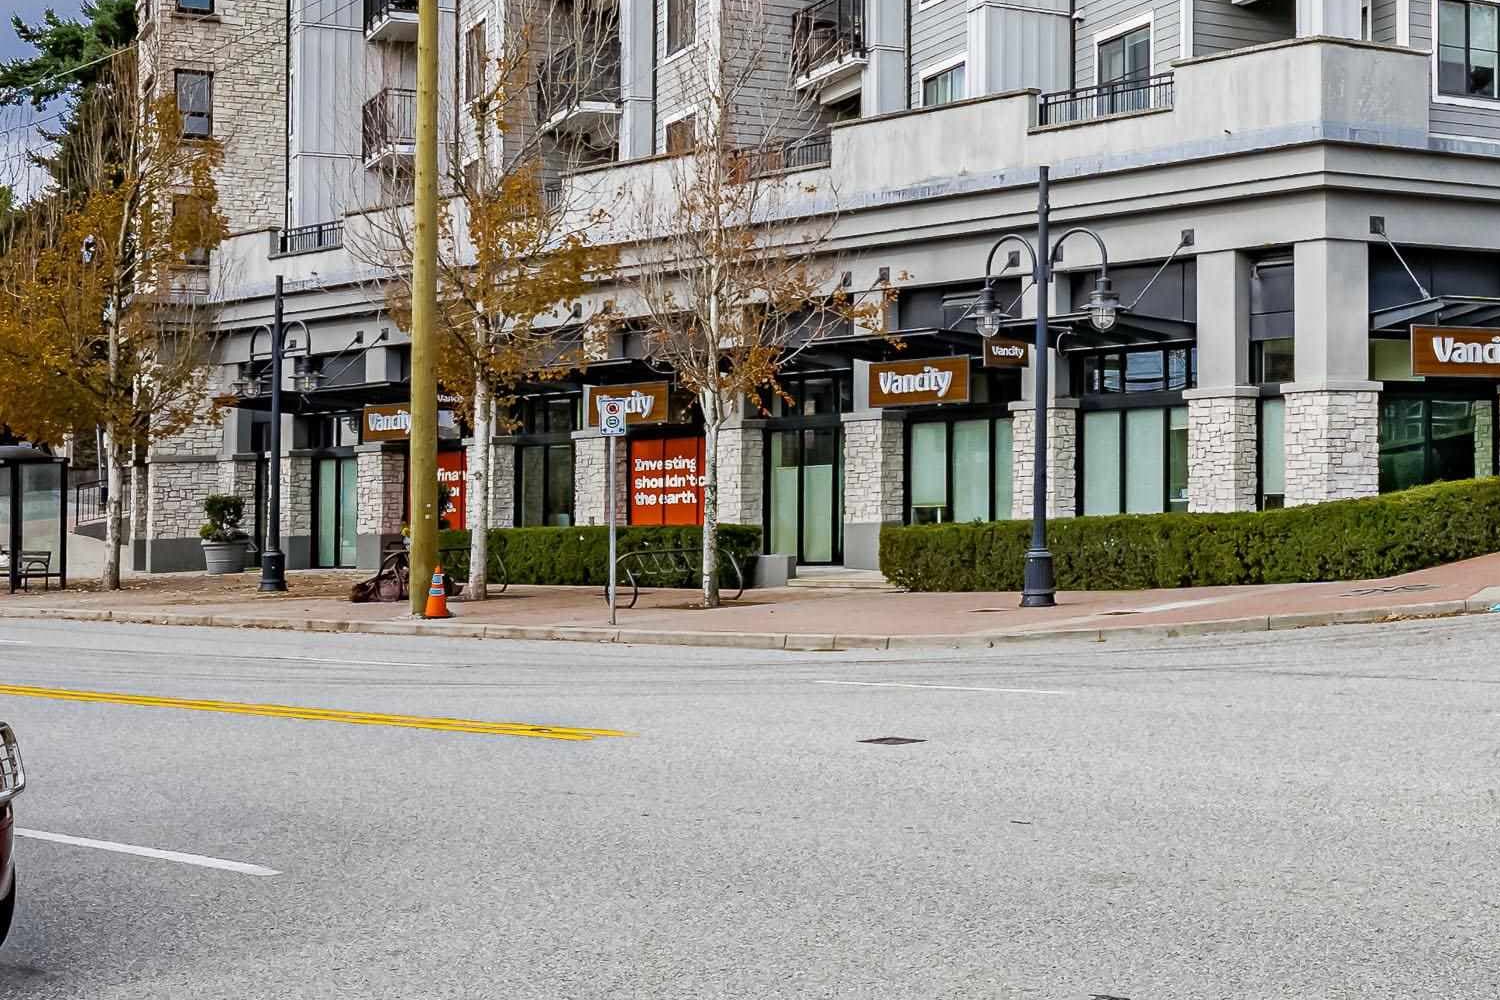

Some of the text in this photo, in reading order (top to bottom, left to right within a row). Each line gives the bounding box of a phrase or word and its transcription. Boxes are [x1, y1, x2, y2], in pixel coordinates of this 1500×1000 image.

[992, 345, 1024, 359] Vancity
[879, 366, 953, 397] Vancity
[634, 456, 697, 473] Investing
[634, 474, 697, 489] shouldn't
[635, 490, 697, 506] the earth.
